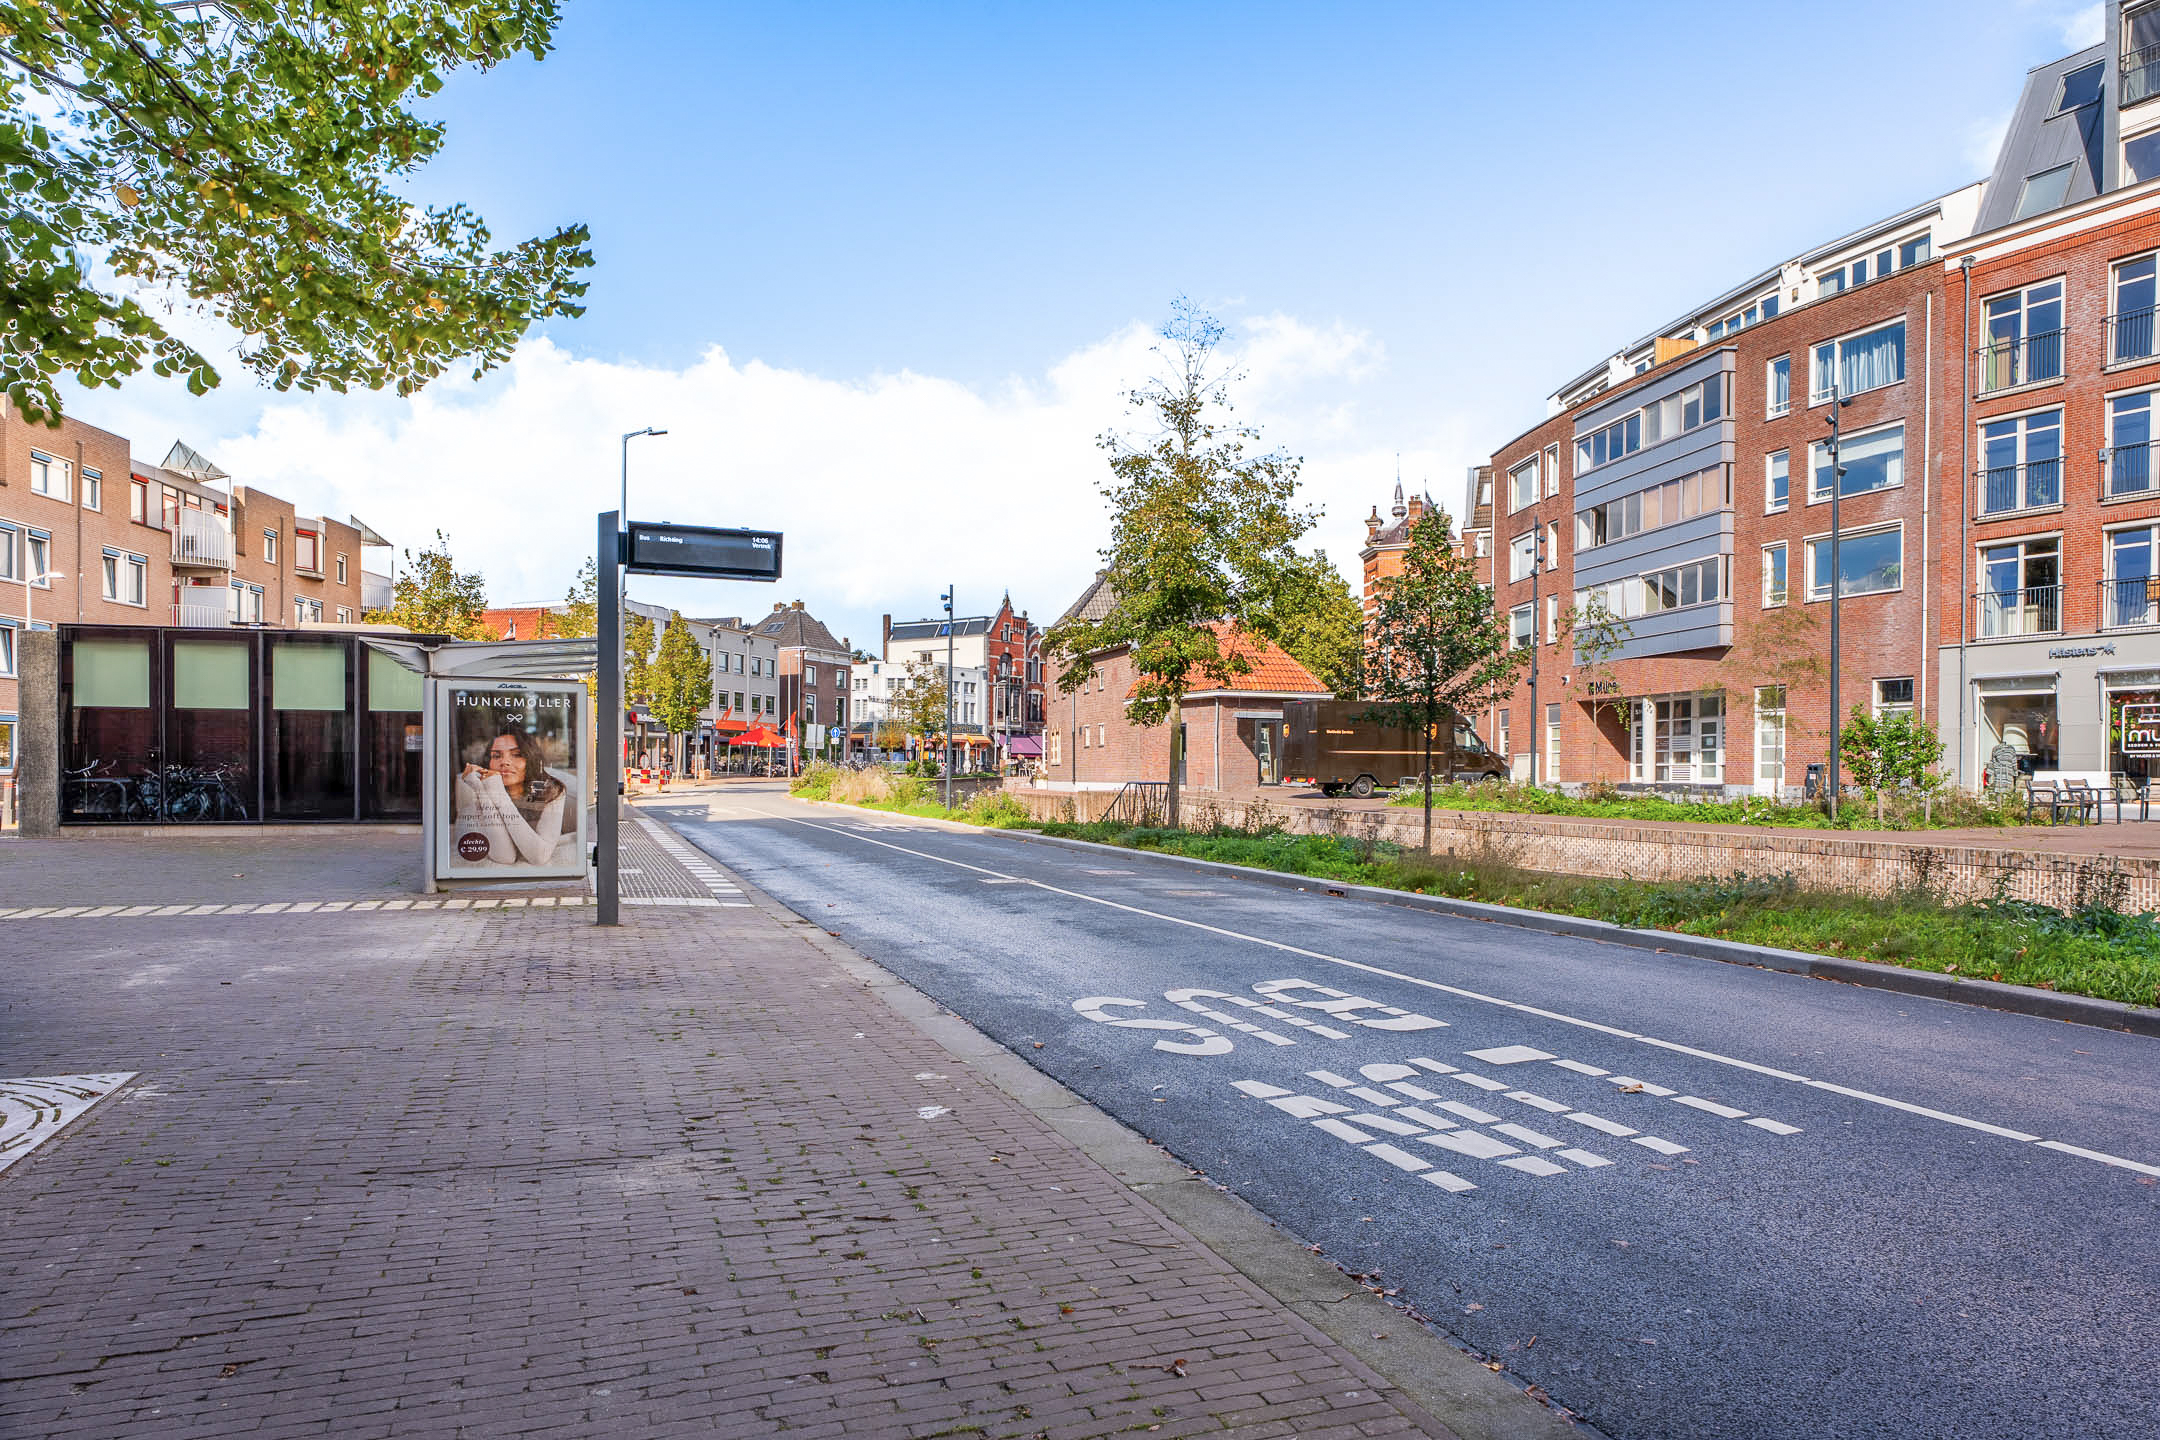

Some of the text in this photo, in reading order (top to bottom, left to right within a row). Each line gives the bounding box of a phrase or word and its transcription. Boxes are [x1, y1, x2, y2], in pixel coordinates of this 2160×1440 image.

[659, 536, 684, 544] Richting
[1071, 978, 1451, 1056] BUS
[1229, 1044, 1803, 1193] LIJN
